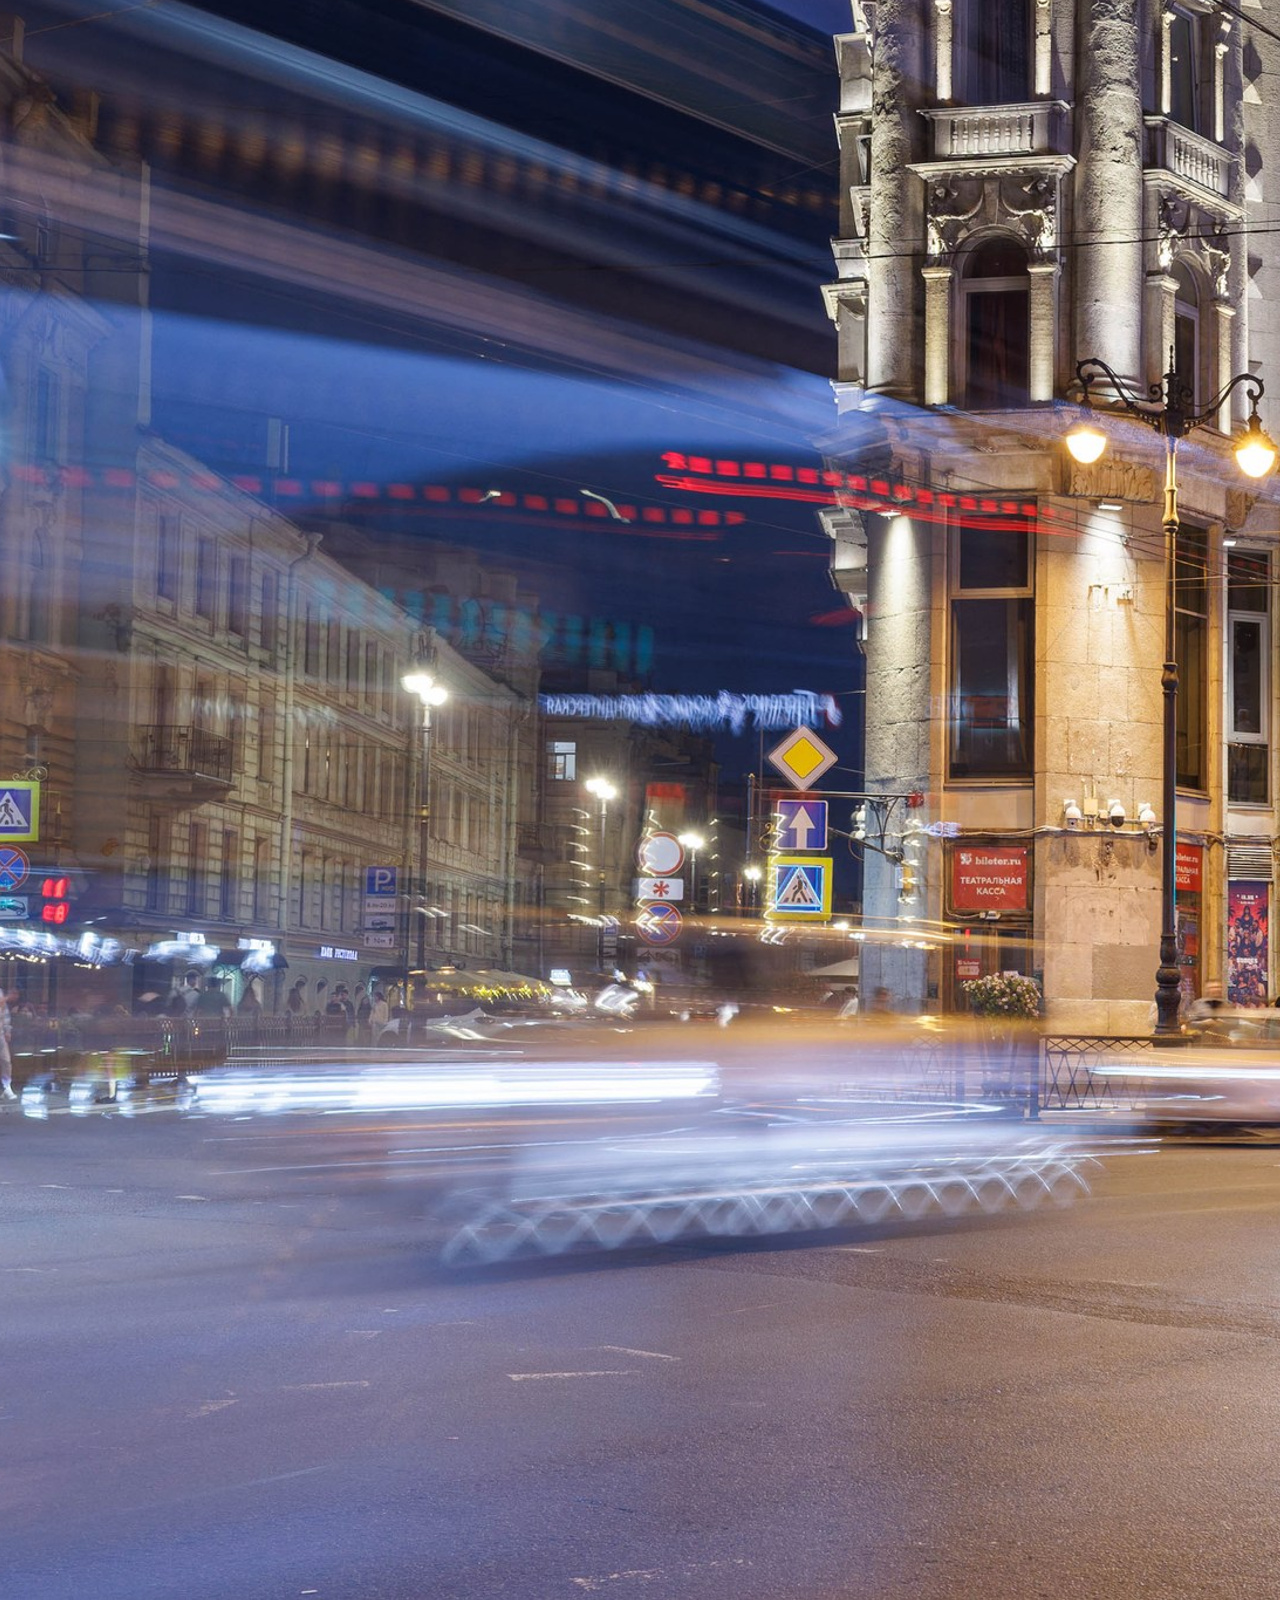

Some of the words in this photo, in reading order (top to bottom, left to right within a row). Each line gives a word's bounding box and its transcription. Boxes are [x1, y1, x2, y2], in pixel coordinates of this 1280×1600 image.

[975, 856, 1021, 866] bileter.ru
[375, 869, 391, 892] P
[960, 876, 1023, 885] ТЕАТРАЛЬНАЯ
[976, 887, 1006, 895] КАССА
